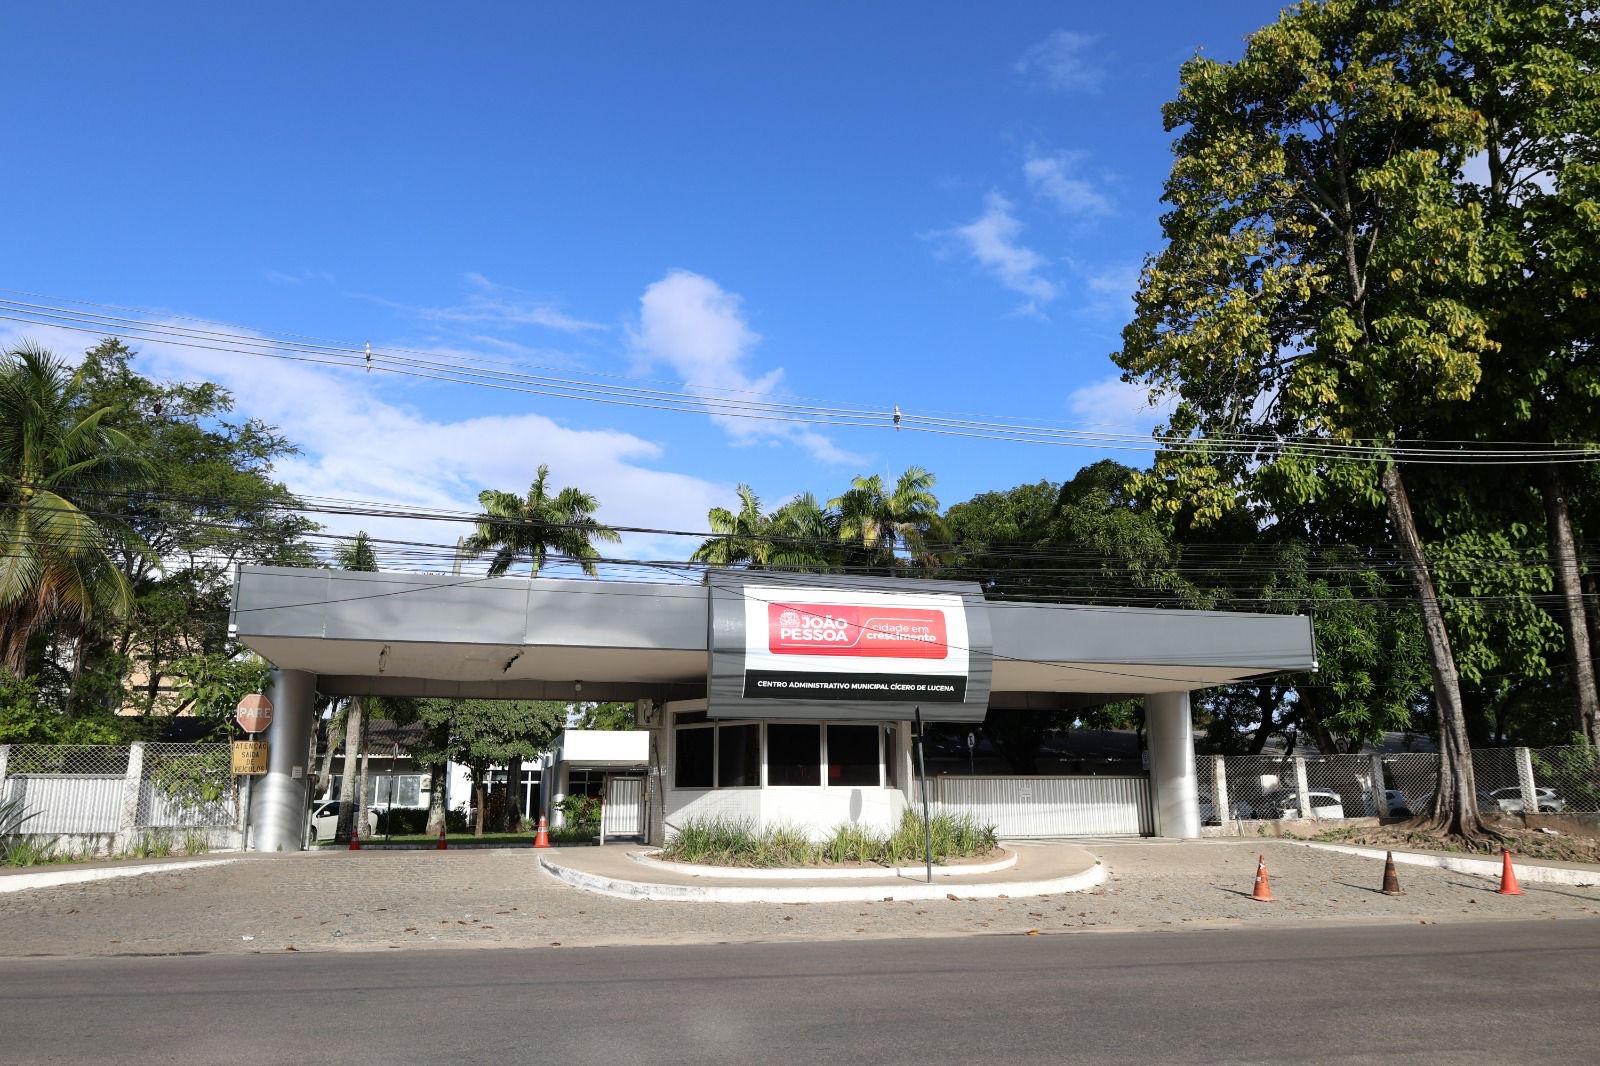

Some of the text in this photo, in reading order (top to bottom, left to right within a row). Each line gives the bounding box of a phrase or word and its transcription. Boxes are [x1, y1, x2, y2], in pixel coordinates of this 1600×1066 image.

[802, 615, 848, 629] JOÃO
[872, 623, 910, 633] cidade
[780, 627, 849, 642] PESSOA
[866, 631, 937, 642] crescimento
[757, 680, 788, 688] CENTRO
[788, 681, 850, 689] ADMINISTRATIVO
[890, 683, 916, 691] CÍCERO
[927, 684, 955, 692] LUCENA
[239, 707, 271, 719] PARE
